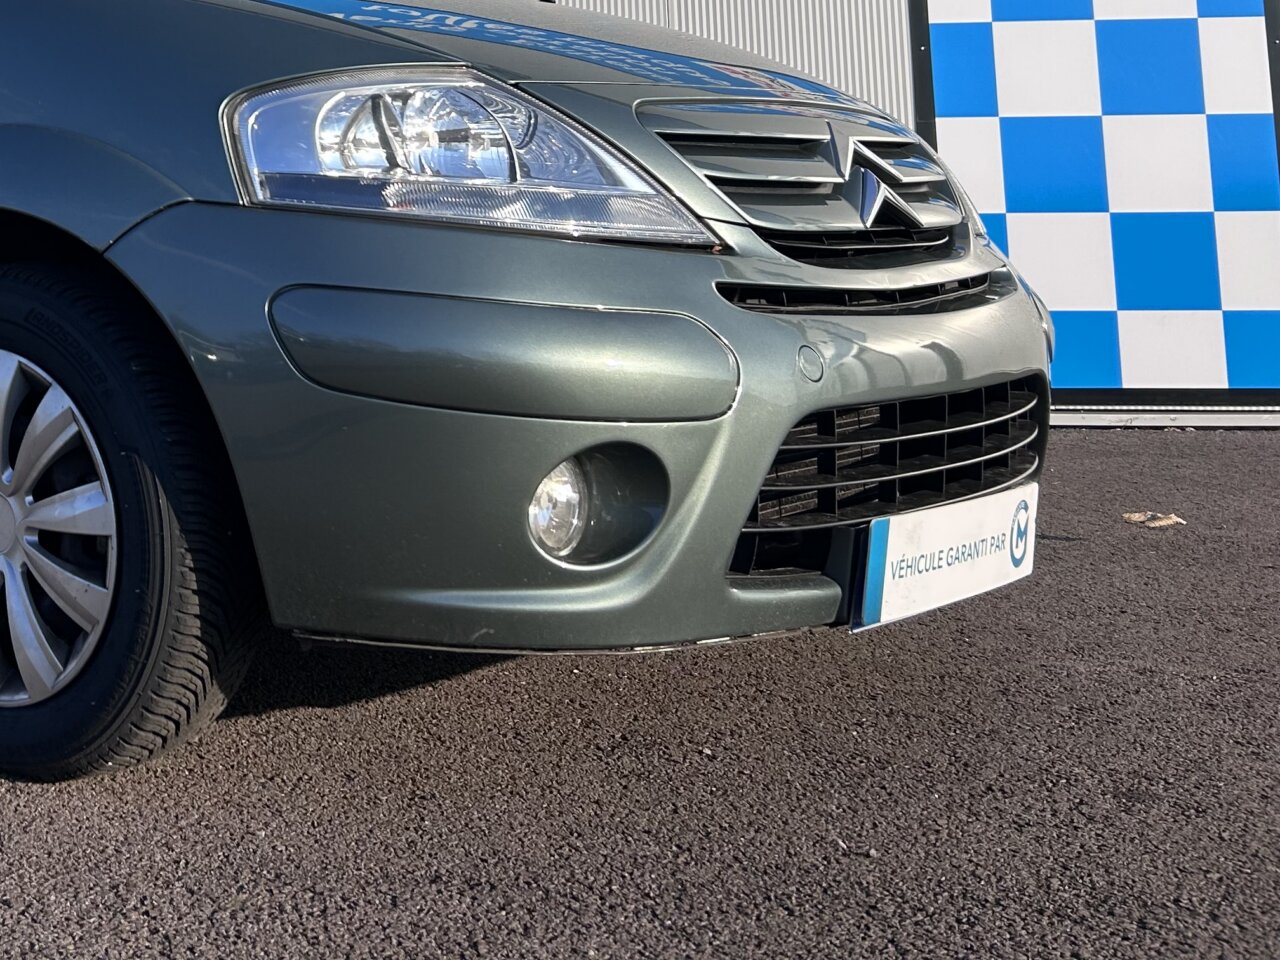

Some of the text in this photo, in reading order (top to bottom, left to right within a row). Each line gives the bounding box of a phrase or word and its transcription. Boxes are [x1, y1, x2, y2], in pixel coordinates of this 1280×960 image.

[890, 532, 1007, 581] VÉHICULE GARANTI PAR
